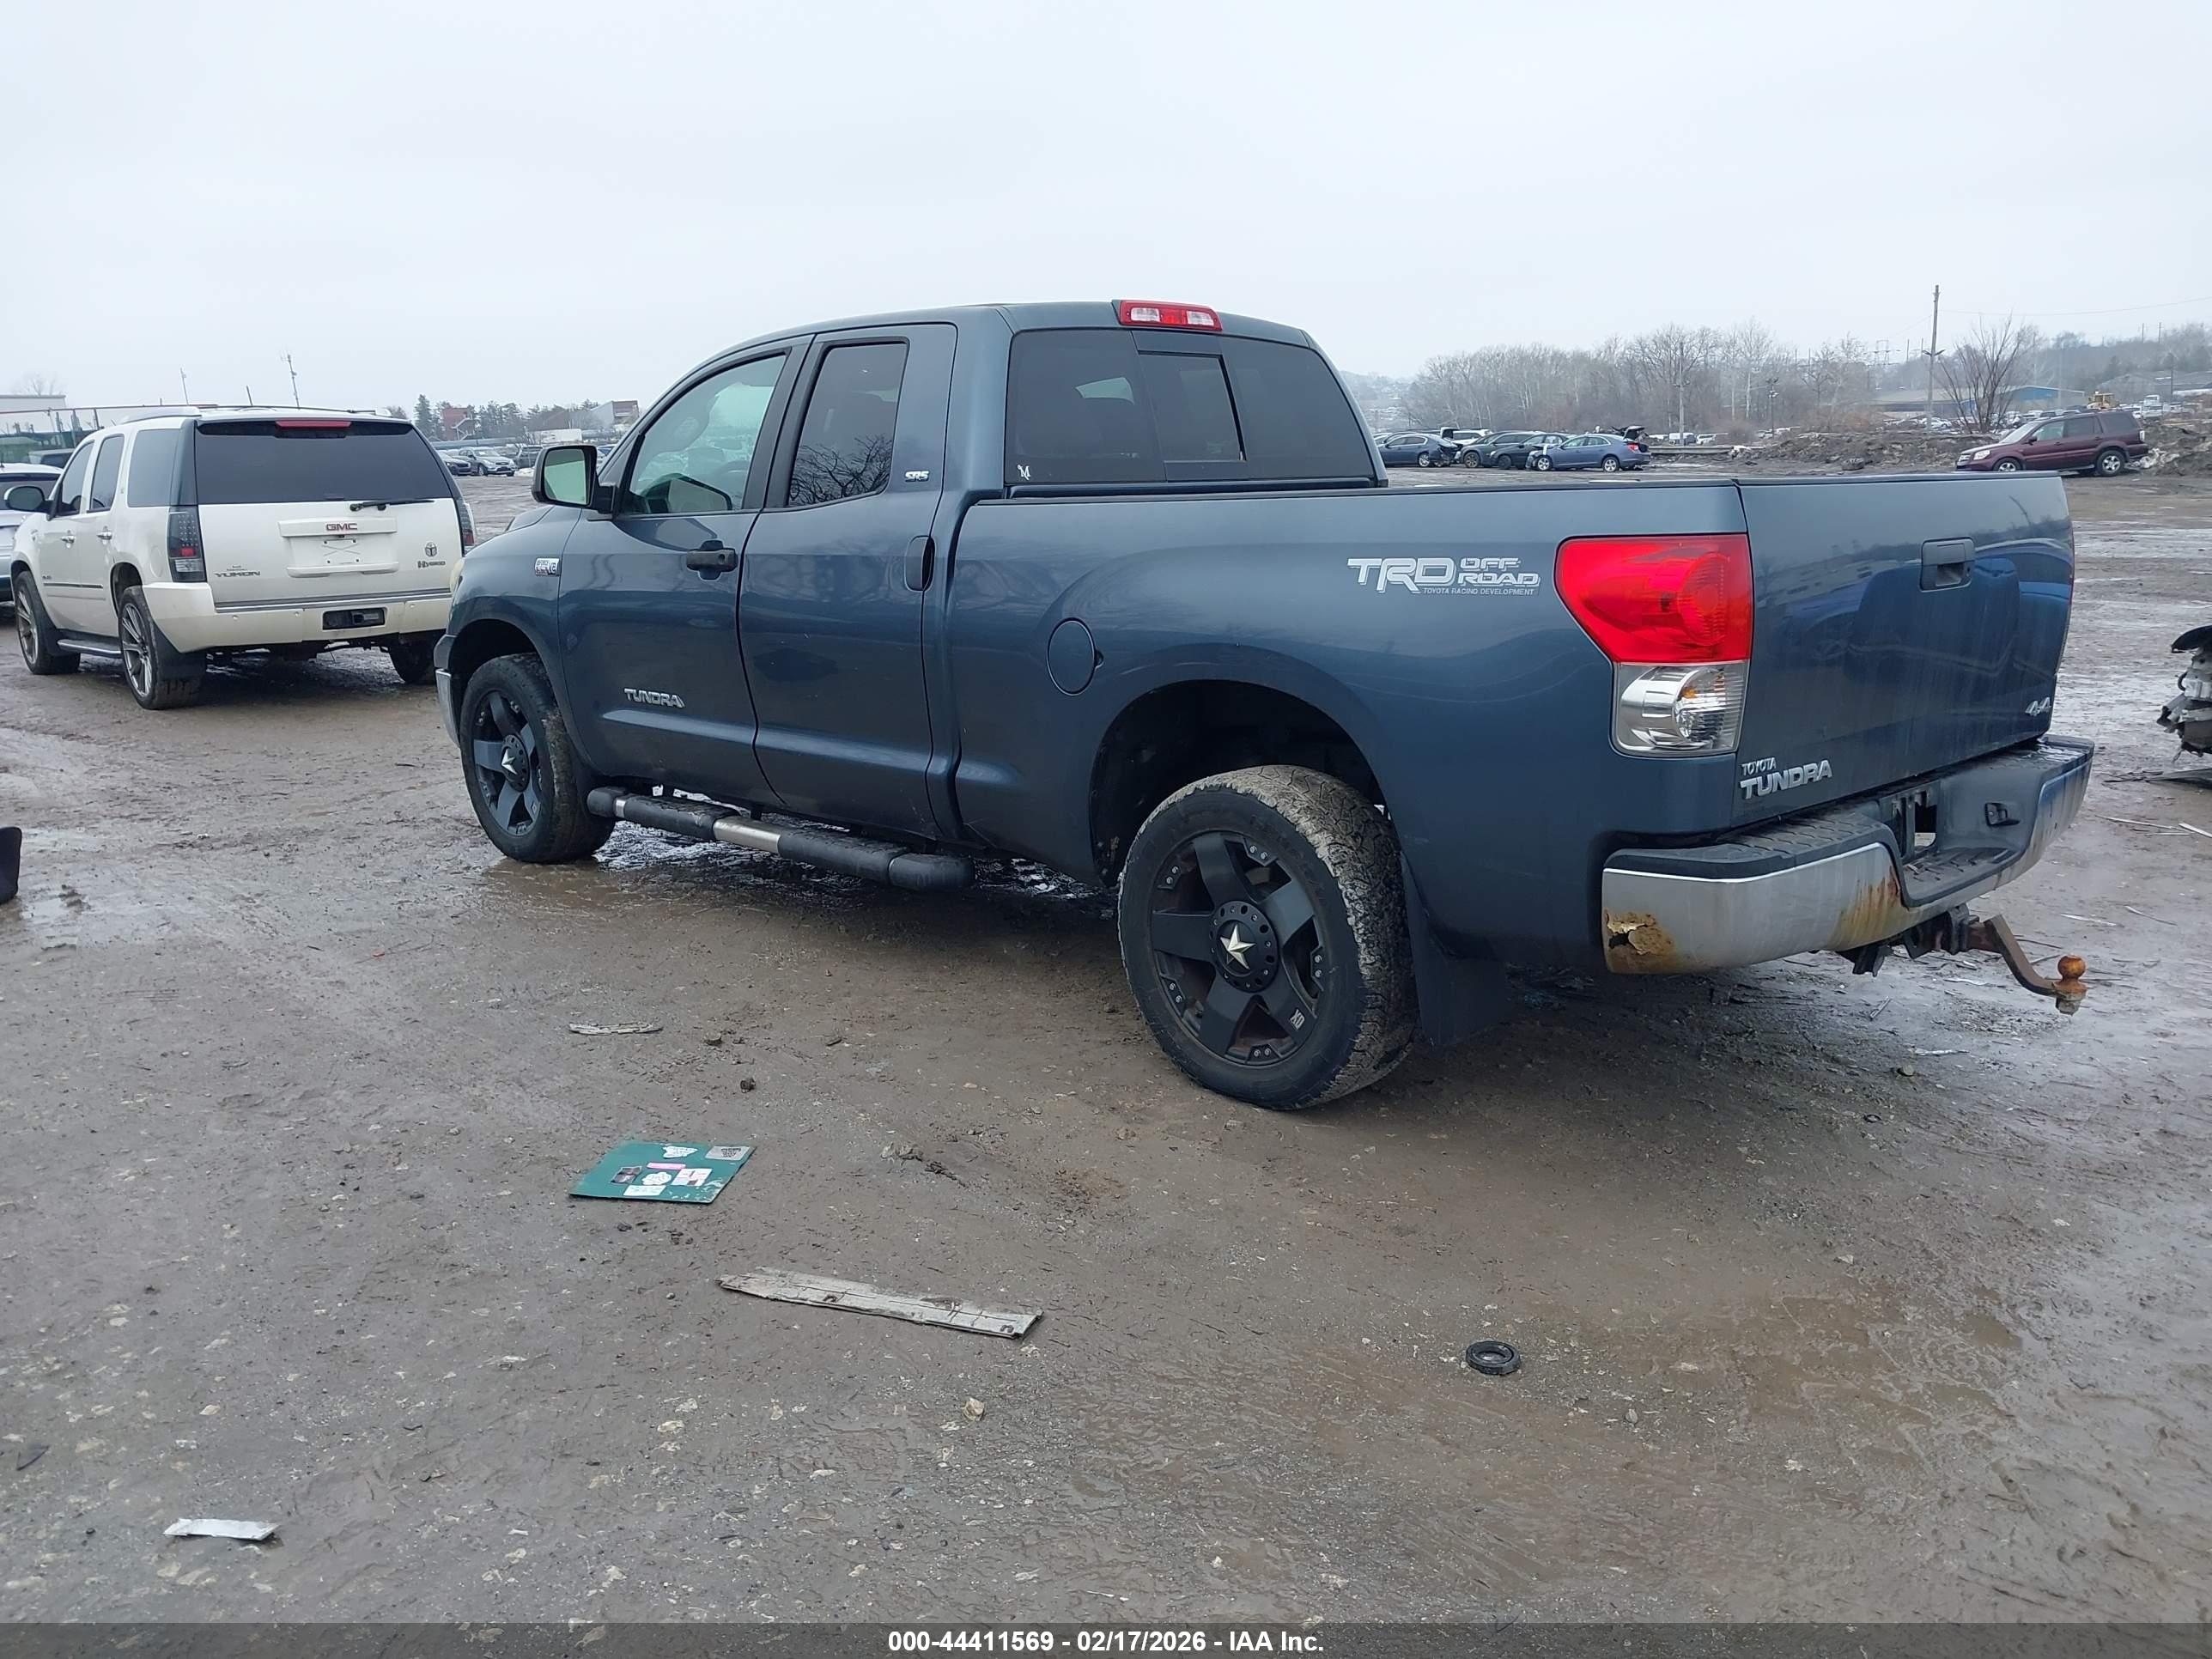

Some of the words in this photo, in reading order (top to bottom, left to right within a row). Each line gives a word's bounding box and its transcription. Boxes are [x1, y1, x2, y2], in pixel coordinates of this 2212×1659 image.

[325, 522, 358, 532] GMC
[1459, 557, 1522, 572] OFF
[1346, 558, 1456, 594] TRD
[1456, 572, 1541, 587] ROAD
[623, 688, 685, 708] TUNDRA
[1741, 757, 1777, 776] TOYOTA
[1740, 759, 1832, 799] TUNDRA
